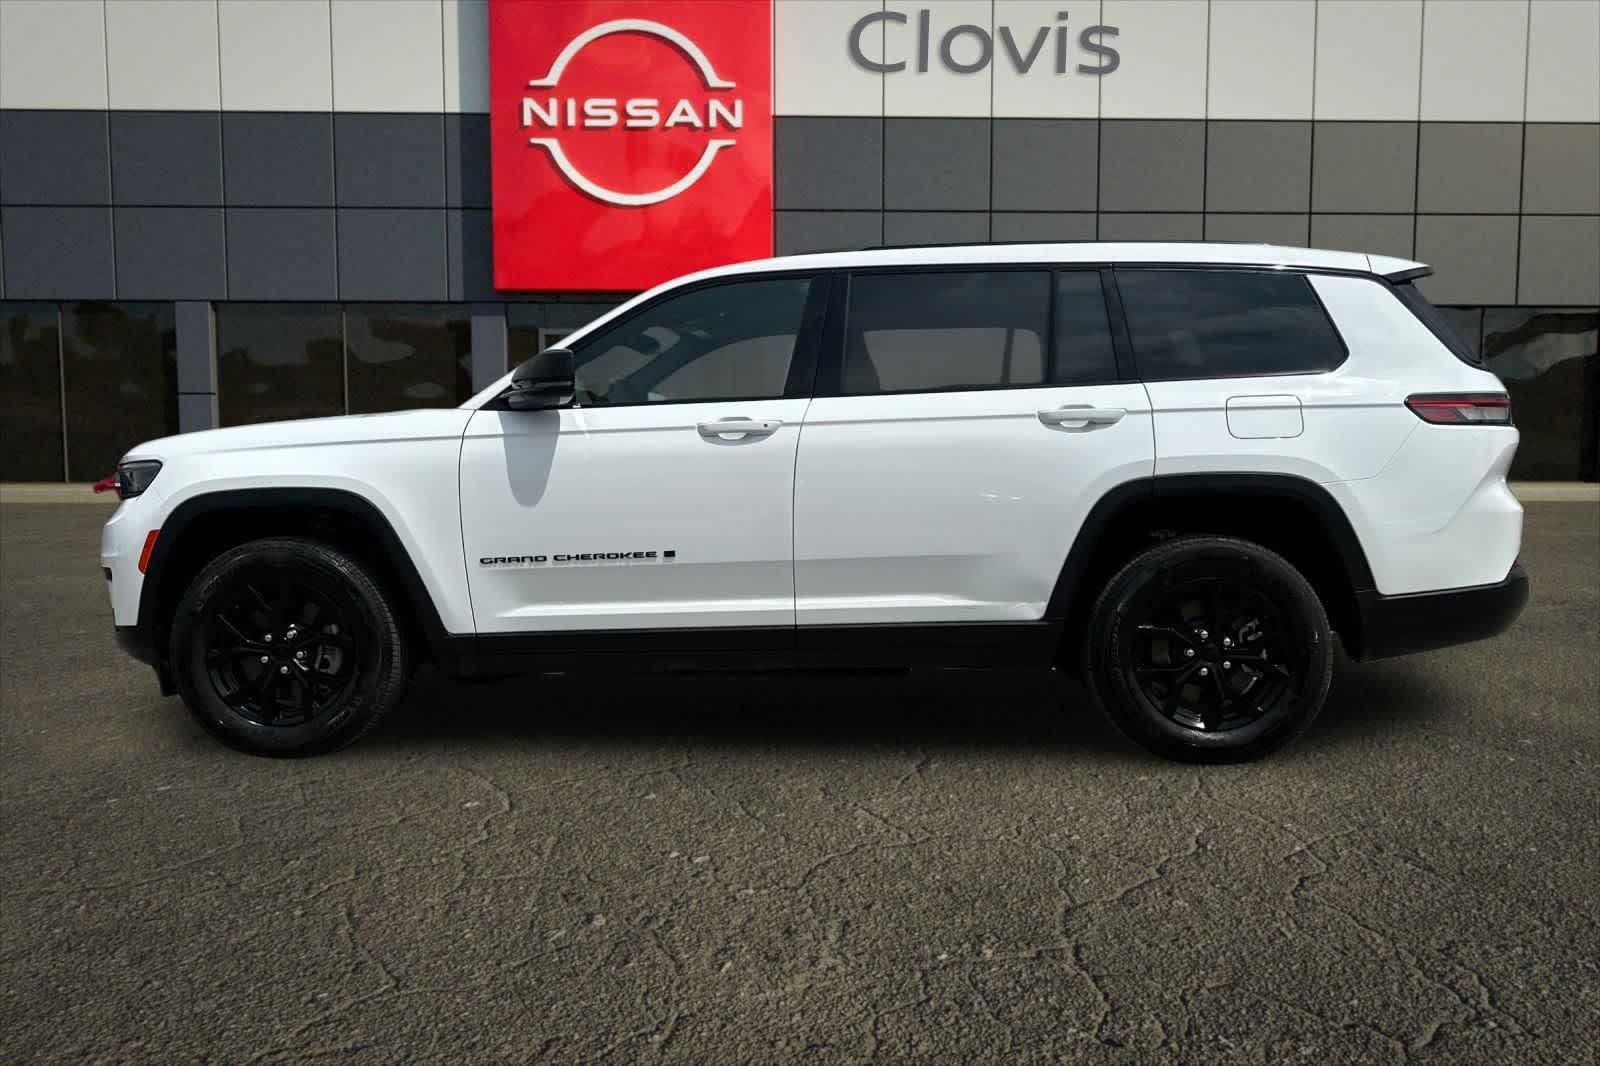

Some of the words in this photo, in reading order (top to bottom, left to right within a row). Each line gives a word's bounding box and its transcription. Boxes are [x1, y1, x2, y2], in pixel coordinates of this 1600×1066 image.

[849, 9, 1120, 75] Clovis
[522, 97, 743, 129] NISSAN
[479, 555, 547, 565] GRAND
[553, 551, 657, 562] CHEROKEE
